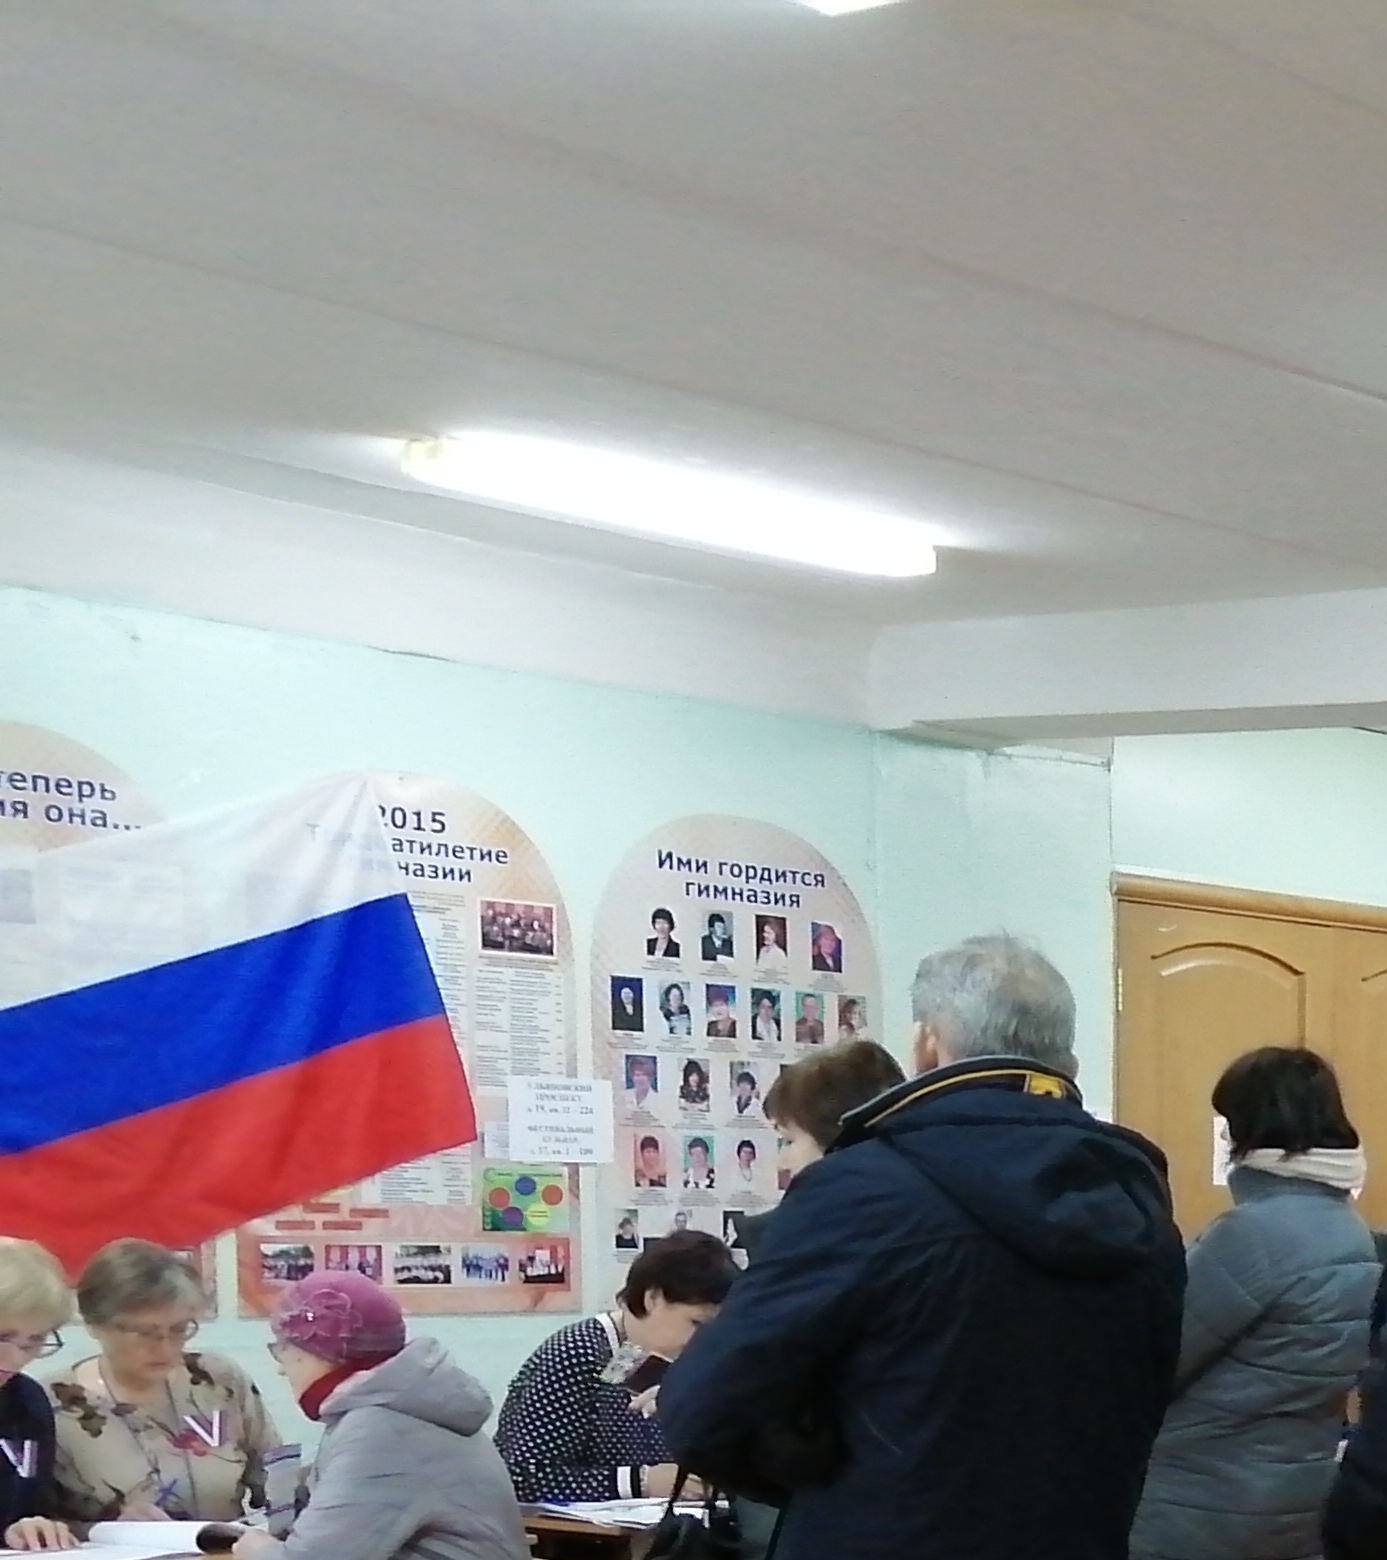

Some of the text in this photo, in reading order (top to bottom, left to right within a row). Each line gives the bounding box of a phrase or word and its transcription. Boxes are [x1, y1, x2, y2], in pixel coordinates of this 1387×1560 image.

[0, 799, 28, 819] я
[391, 836, 509, 865] атилетие
[397, 860, 472, 883] назии
[657, 849, 825, 888] Ими гордится
[685, 881, 801, 908] гимназия
